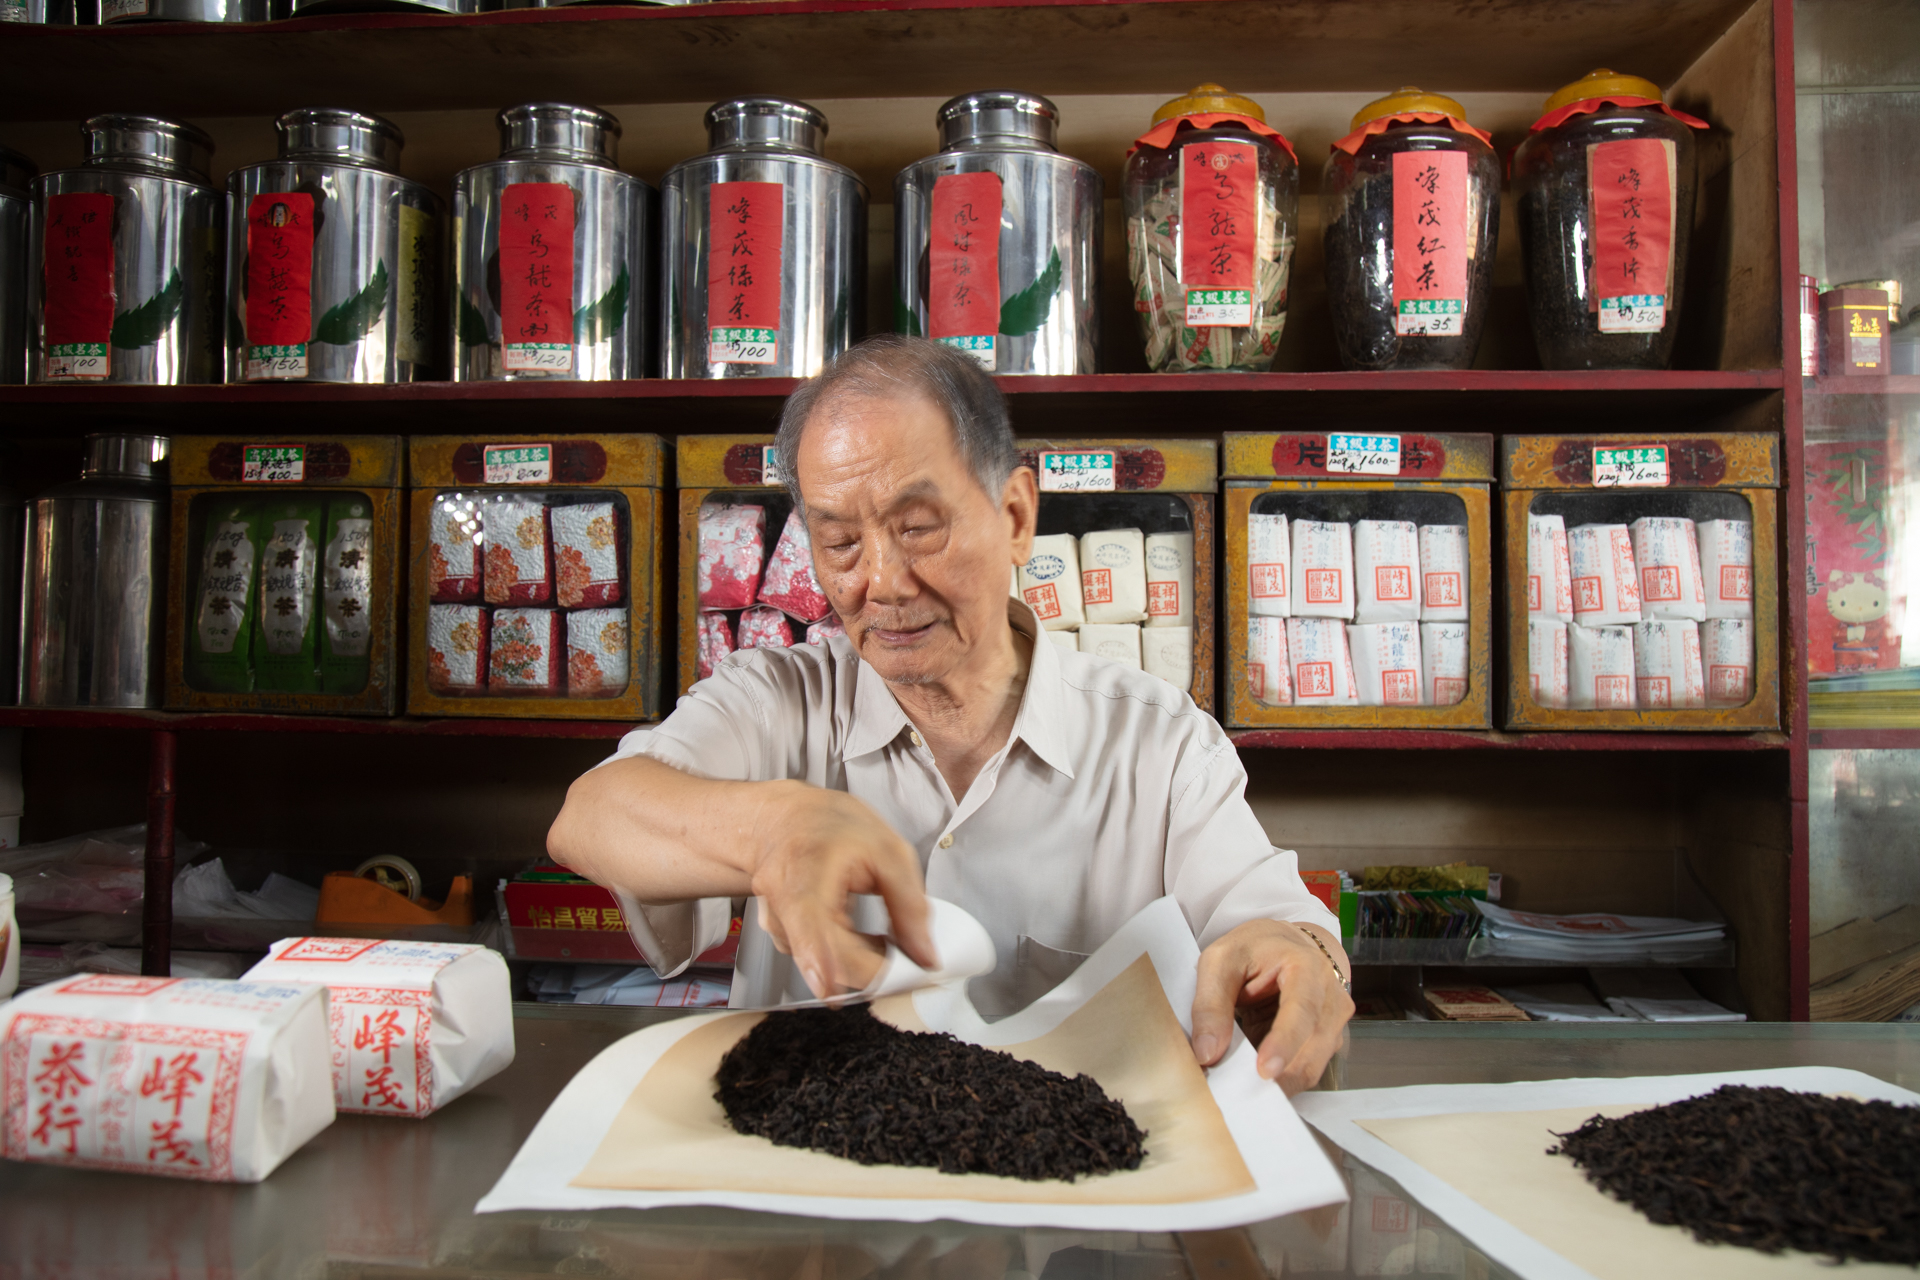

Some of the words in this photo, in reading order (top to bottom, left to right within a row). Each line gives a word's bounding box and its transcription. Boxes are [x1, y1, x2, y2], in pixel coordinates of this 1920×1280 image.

[1192, 291, 1248, 304] 高級茗茶
[1404, 300, 1459, 314] 高級茗茶
[716, 329, 772, 342] 高級茗茶
[53, 343, 103, 357] 高級茗茶
[1335, 436, 1395, 452] 高級茗茶
[491, 448, 546, 463] 高級茗茶
[1050, 455, 1109, 469] 高級茗茶
[1600, 448, 1662, 464] 高級茗茶
[209, 596, 231, 616] 茶
[273, 596, 297, 617] 茶
[338, 597, 362, 618] 茶
[527, 905, 630, 932] 怡昌貿易
[353, 1008, 408, 1111] 峰茂
[31, 1040, 95, 1155] 茶行
[139, 1050, 205, 1167] 峰茂
